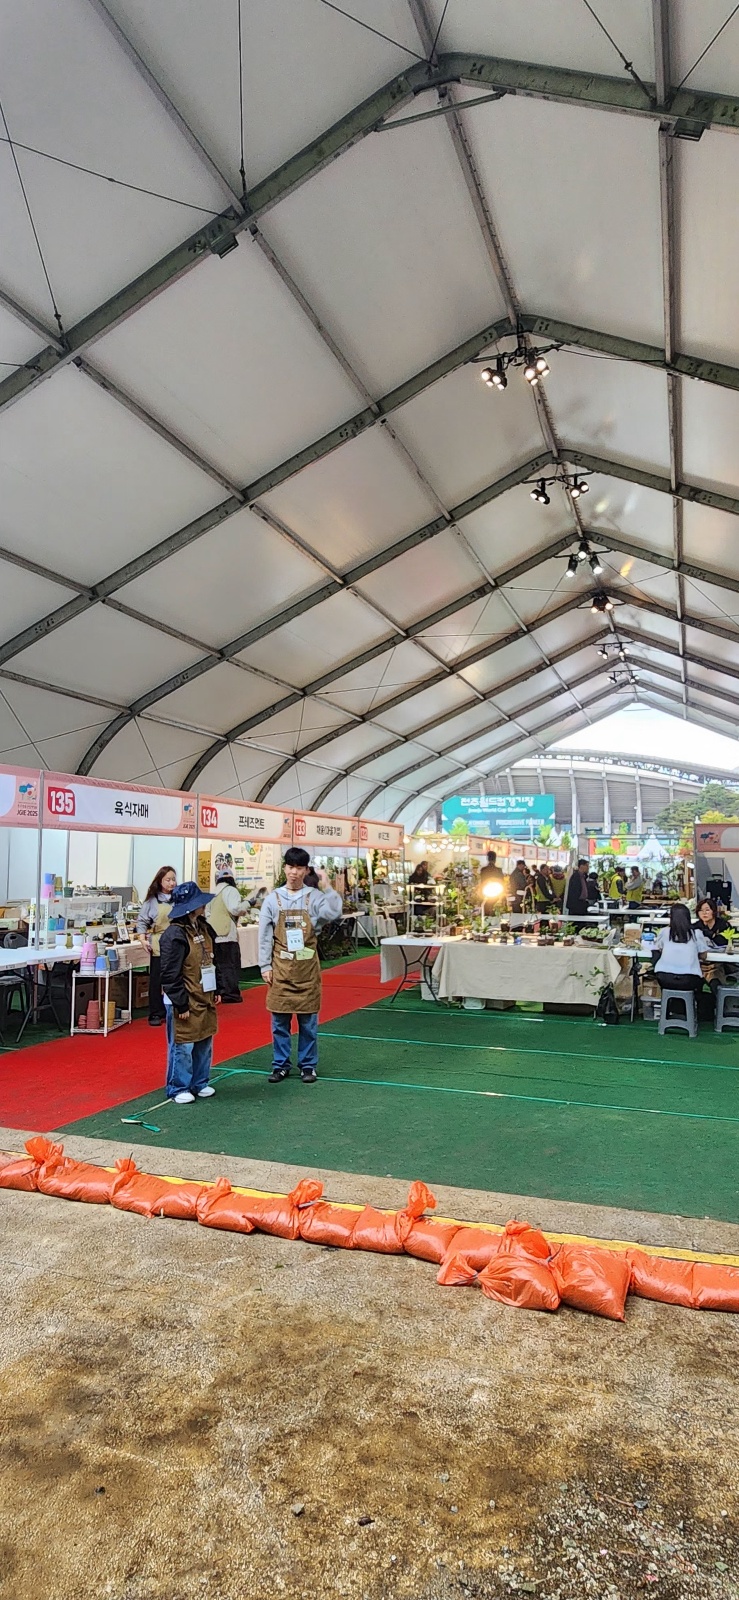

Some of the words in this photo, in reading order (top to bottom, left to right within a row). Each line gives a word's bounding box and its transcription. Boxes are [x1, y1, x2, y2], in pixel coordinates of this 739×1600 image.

[50, 791, 74, 814] 135
[114, 801, 149, 818] 육식자매
[460, 797, 534, 807] 전주월드컵경기장
[202, 808, 217, 827] 134
[295, 820, 306, 836] 133
